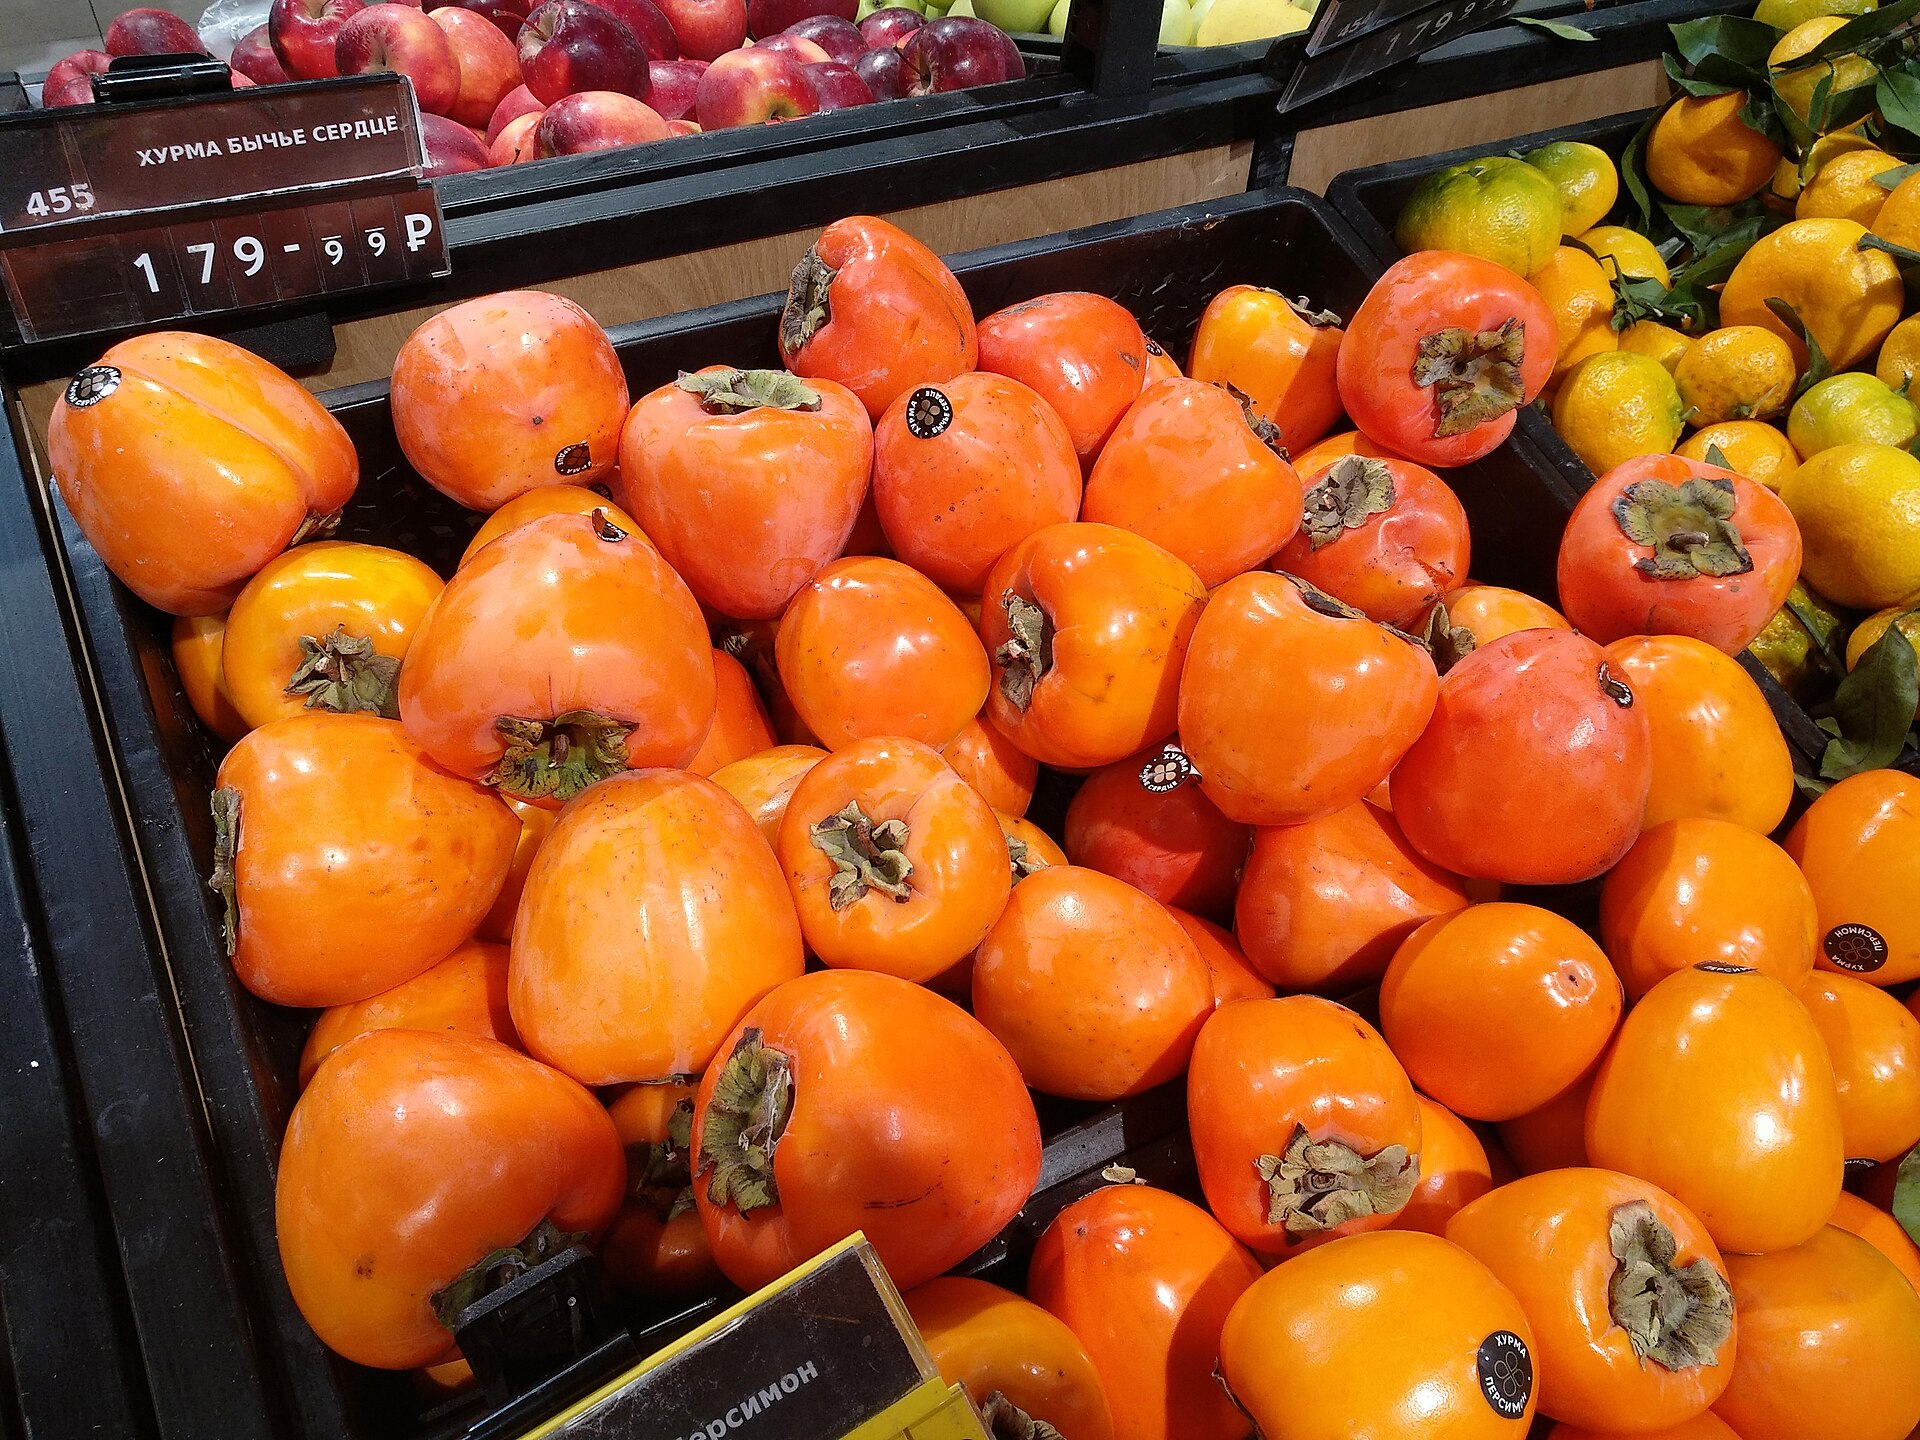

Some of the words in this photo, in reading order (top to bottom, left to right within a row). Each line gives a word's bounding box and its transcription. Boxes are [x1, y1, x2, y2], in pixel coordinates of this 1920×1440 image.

[137, 141, 222, 167] ХУРМА
[228, 128, 307, 155] БЫЧЬЕ
[312, 115, 398, 144] СЕРДЦЕ
[26, 183, 95, 217] 455
[925, 390, 950, 411] СЕРДЦЕ
[908, 400, 922, 435] ХУРМА
[1163, 752, 1189, 773] ХУРМА
[1834, 927, 1883, 951] ПЕРСИМОН
[1831, 955, 1865, 971] ХУРМА
[1495, 1334, 1526, 1358] ХУРМА
